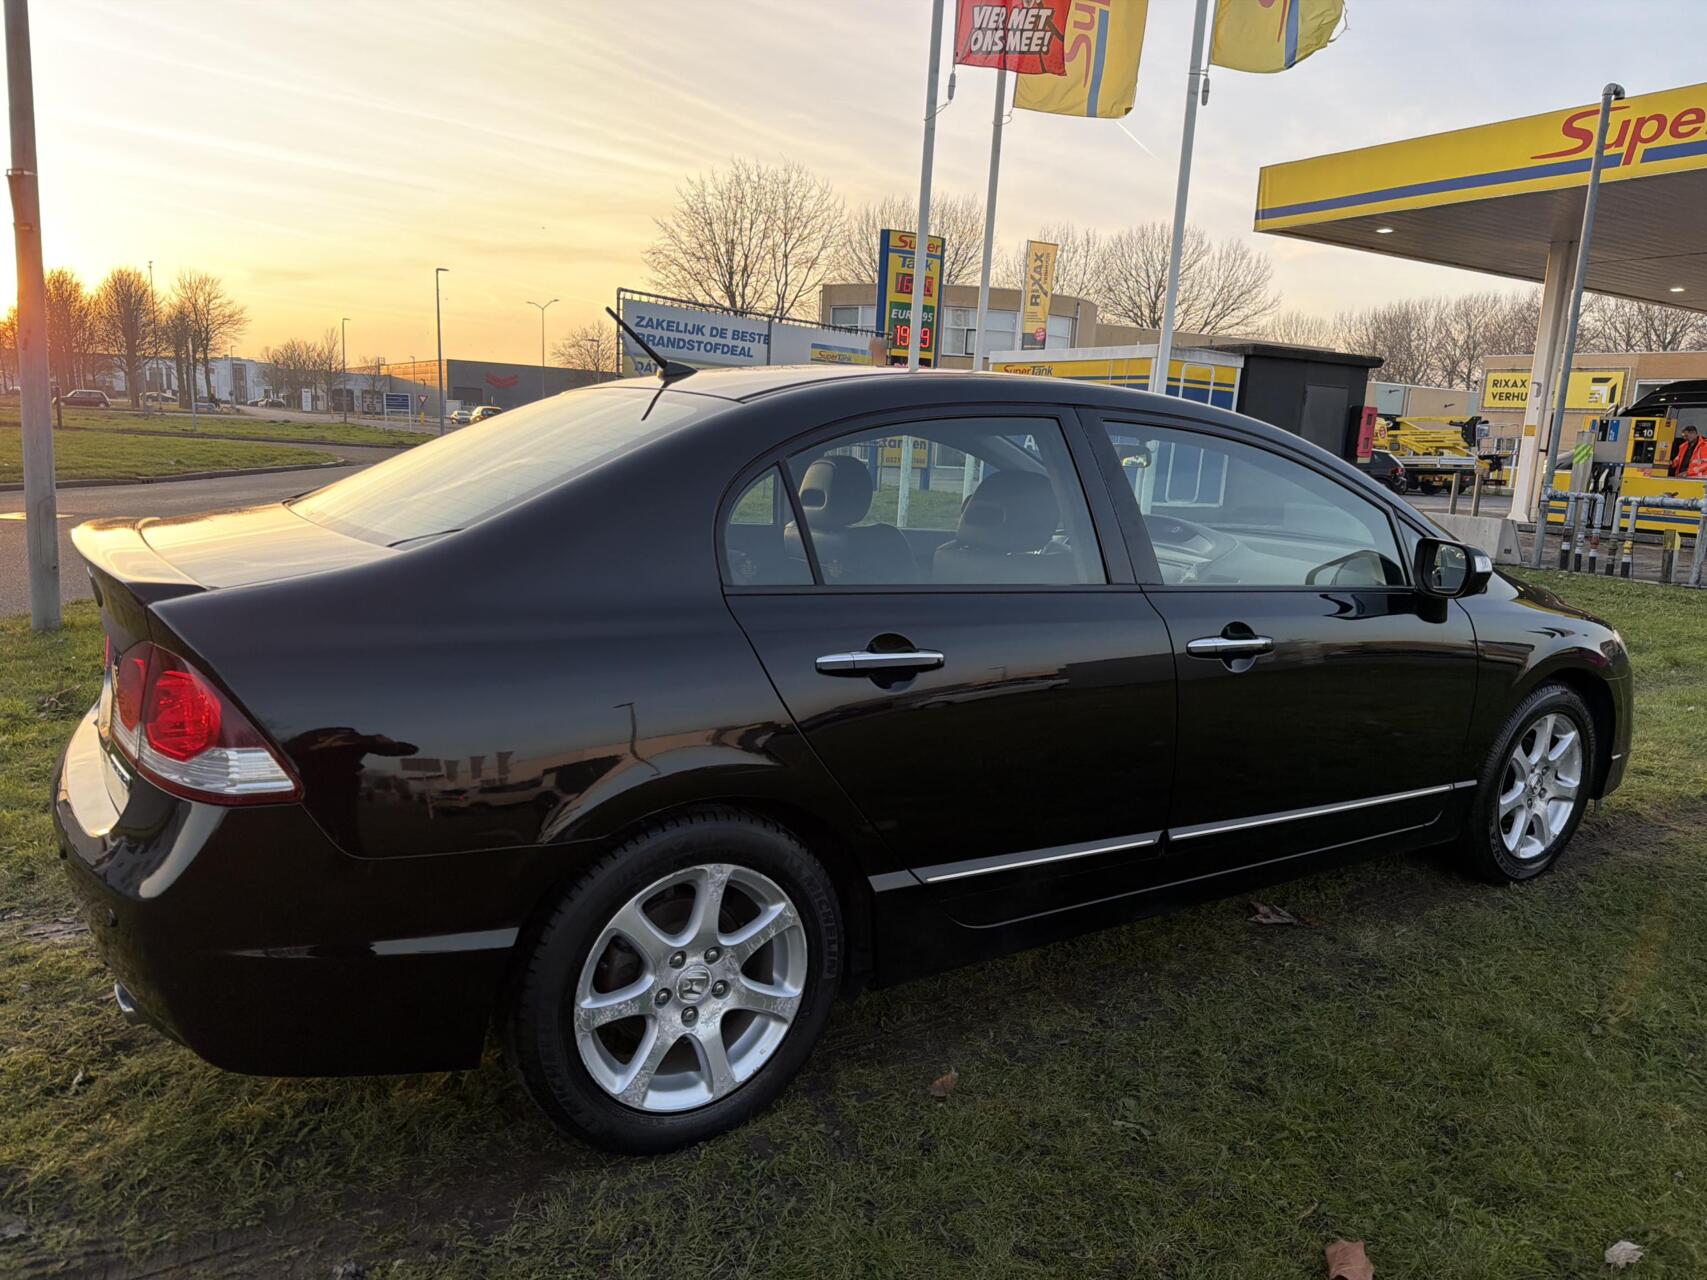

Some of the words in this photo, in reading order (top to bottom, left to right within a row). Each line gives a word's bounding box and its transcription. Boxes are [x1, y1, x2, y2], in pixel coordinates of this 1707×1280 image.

[972, 6, 1006, 29] VIER
[1008, 7, 1054, 30] MET
[970, 30, 1004, 53] ONS
[1006, 31, 1051, 53] MEE!
[1064, 0, 1109, 88] Su
[1530, 105, 1707, 166] Supe
[891, 234, 940, 253] Suer
[898, 255, 933, 271] Tak
[897, 275, 933, 295] 160
[635, 315, 706, 337] ZAKELIJK
[709, 326, 728, 339] DE
[896, 325, 930, 348] 199
[1492, 379, 1527, 388] RIXAX
[1492, 392, 1528, 402] VERHU
[1643, 429, 1653, 437] 10
